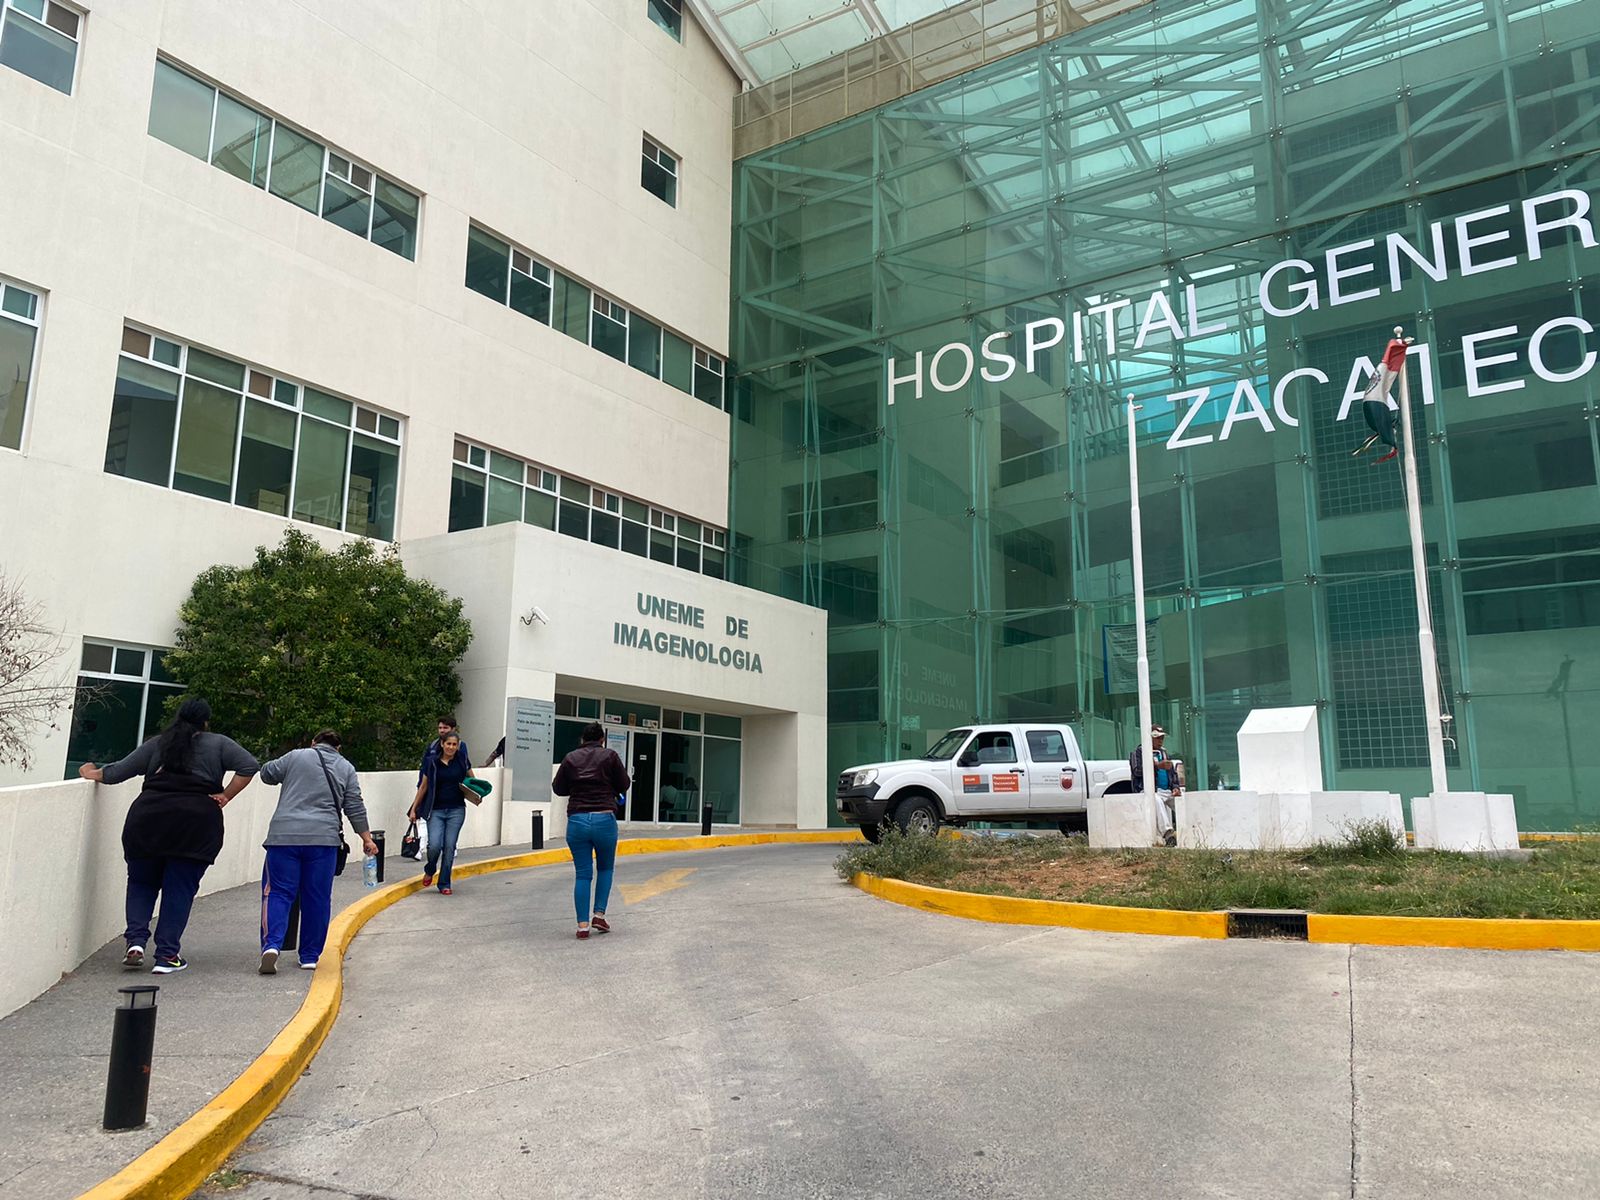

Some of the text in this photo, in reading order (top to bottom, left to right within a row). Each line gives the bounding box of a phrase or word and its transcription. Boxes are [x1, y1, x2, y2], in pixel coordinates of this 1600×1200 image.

[887, 189, 1599, 405] HOSPITAL GENER
[637, 592, 749, 640] UNEME DE
[613, 622, 763, 674] IMAGENOLOGIA
